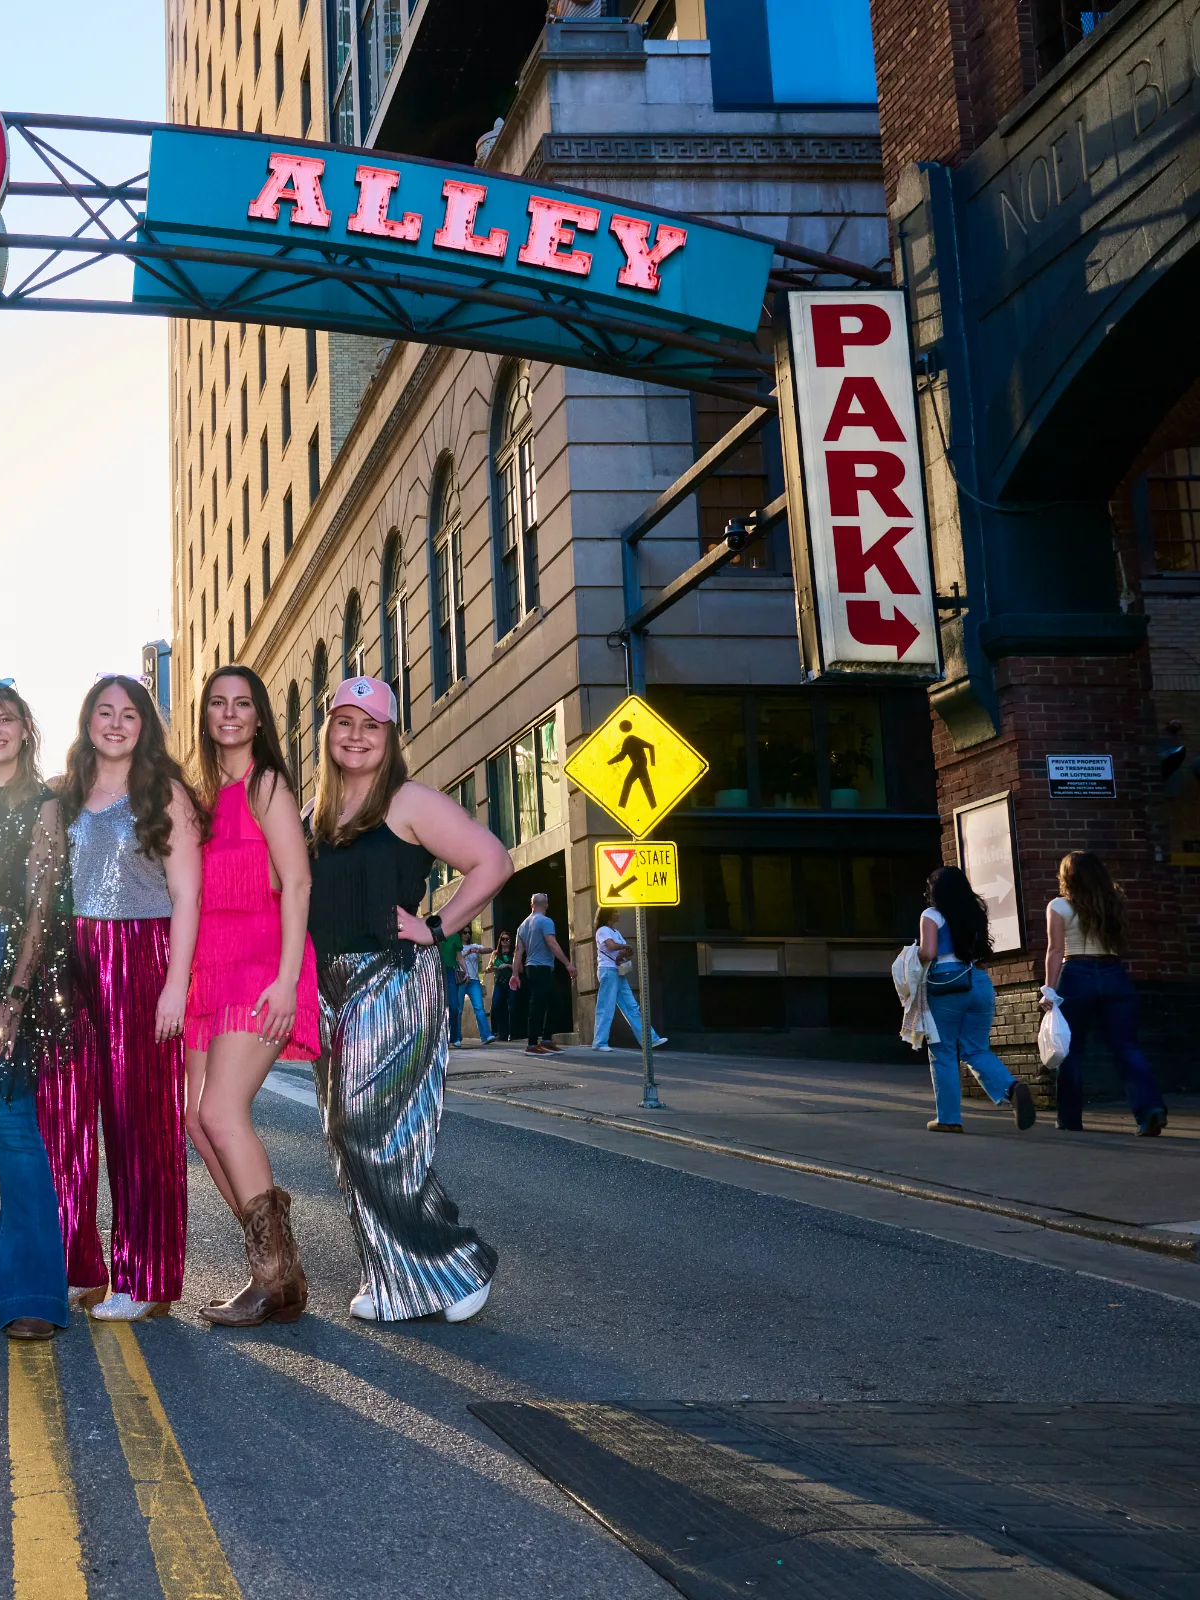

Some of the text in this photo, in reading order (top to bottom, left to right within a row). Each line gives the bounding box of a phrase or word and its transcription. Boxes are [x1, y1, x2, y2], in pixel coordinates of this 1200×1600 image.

[247, 152, 688, 293] ALLEY
[999, 115, 1107, 250] NOEL
[810, 303, 921, 596] PARK
[639, 850, 671, 865] STATE
[646, 871, 668, 887] LAW
